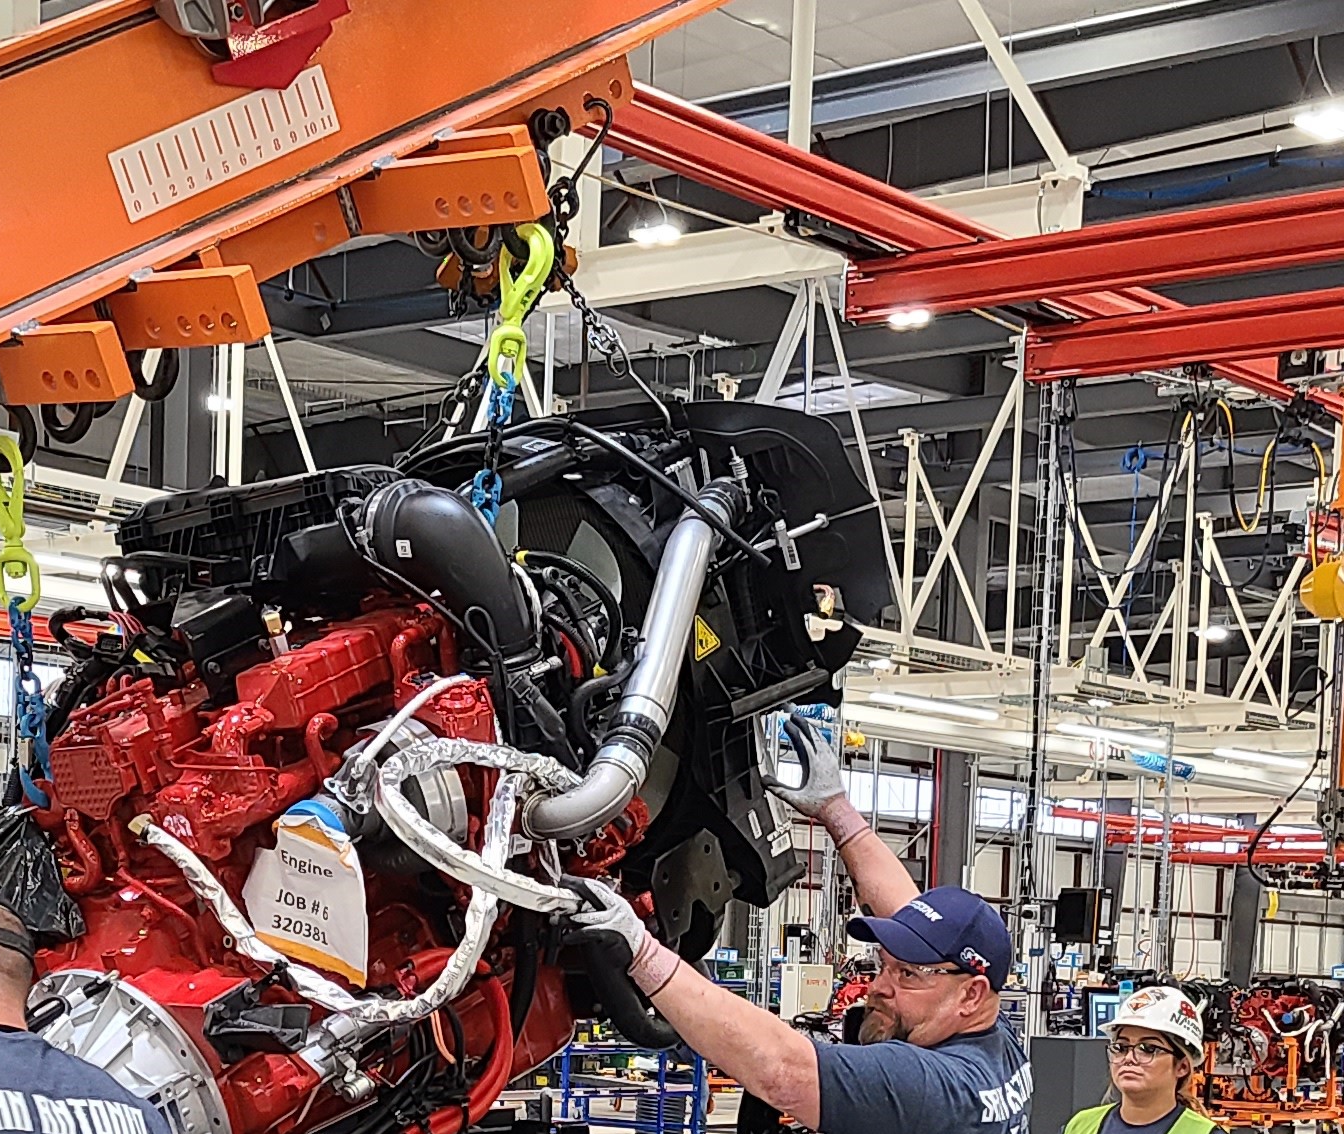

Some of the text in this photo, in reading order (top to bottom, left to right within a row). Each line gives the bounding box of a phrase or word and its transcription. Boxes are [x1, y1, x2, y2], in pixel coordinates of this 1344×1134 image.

[133, 114, 335, 214] 0 1 2 3 4 5 6 7 8 9 10 11
[279, 848, 335, 878] Engine
[274, 888, 330, 921] JOB # 6
[270, 913, 329, 946] 320381
[979, 1087, 1010, 1122] SAN
